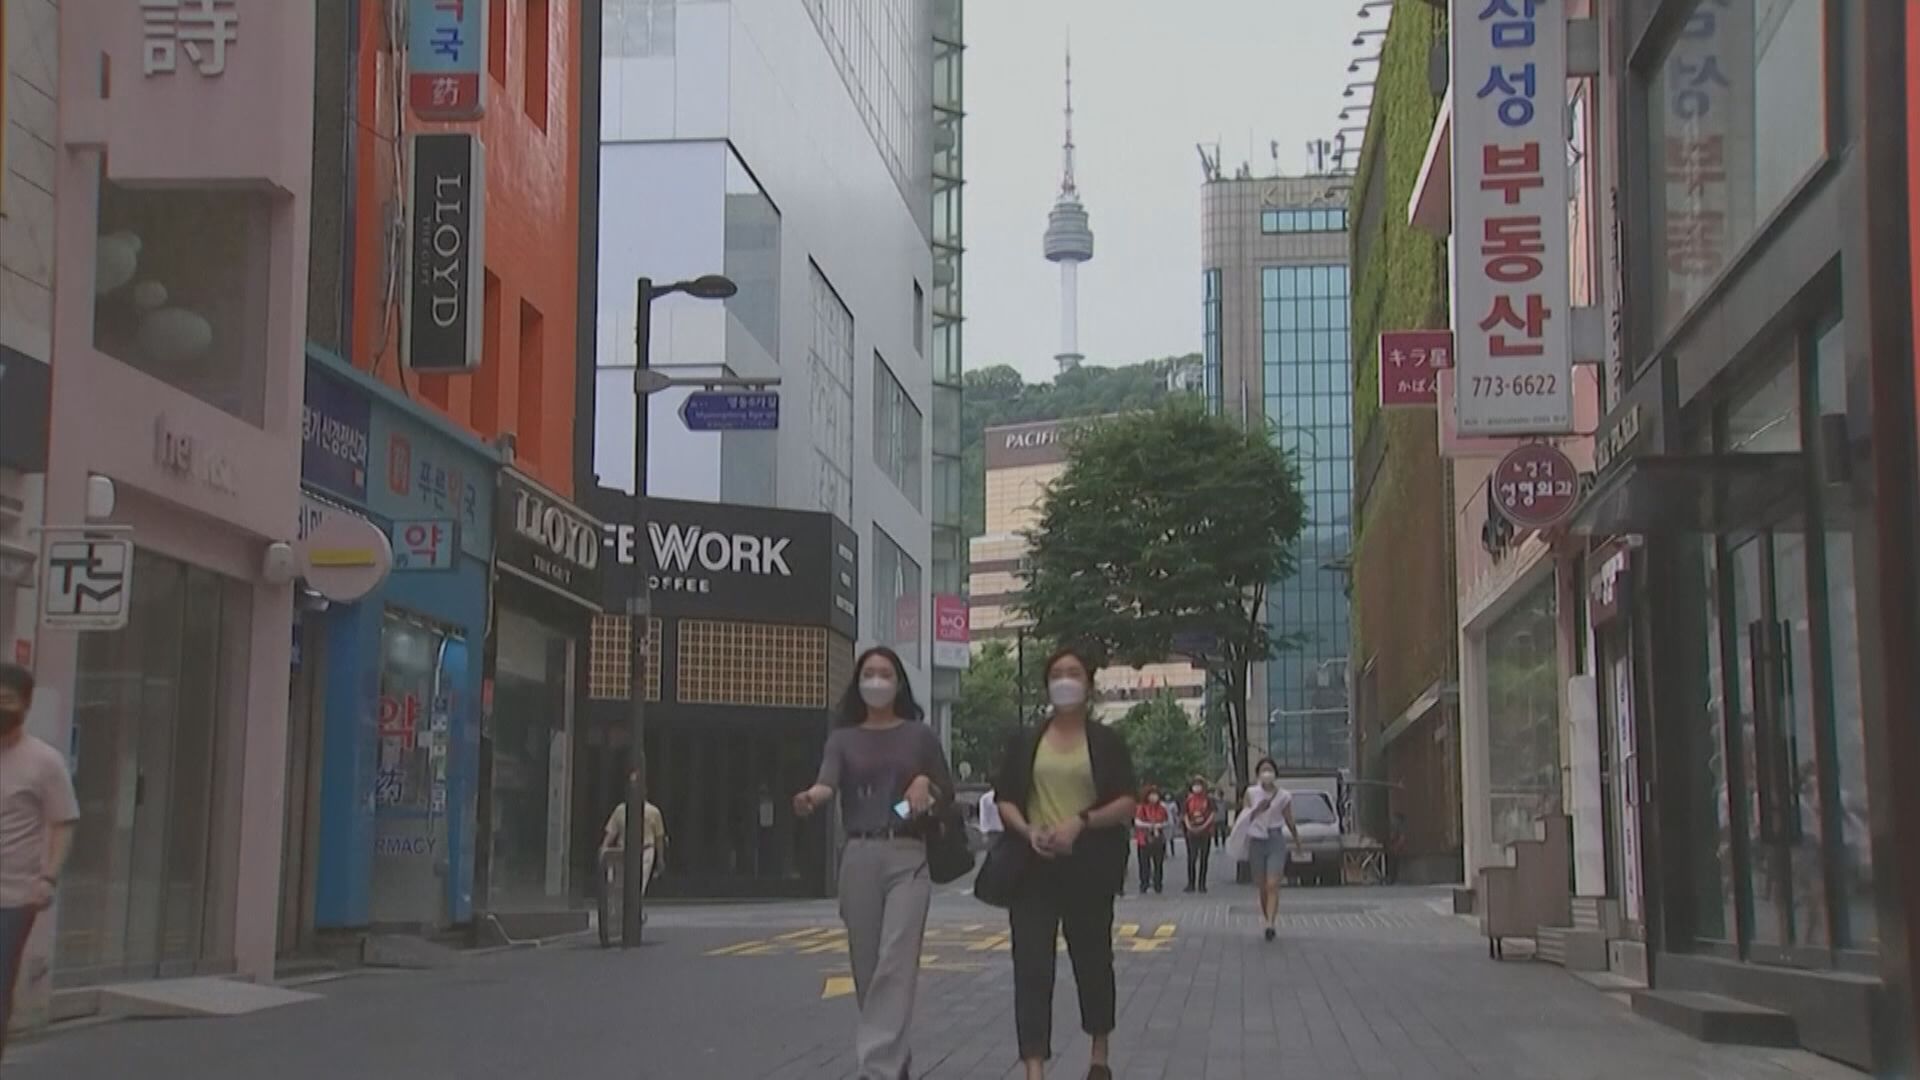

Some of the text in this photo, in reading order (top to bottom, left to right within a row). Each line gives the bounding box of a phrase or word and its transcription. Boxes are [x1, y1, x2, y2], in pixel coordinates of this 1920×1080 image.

[432, 174, 462, 328] LLOYD
[1006, 428, 1061, 449] PACIFIC
[405, 521, 443, 566] 약
[515, 487, 599, 570] LLOYD
[648, 521, 792, 576] WORK
